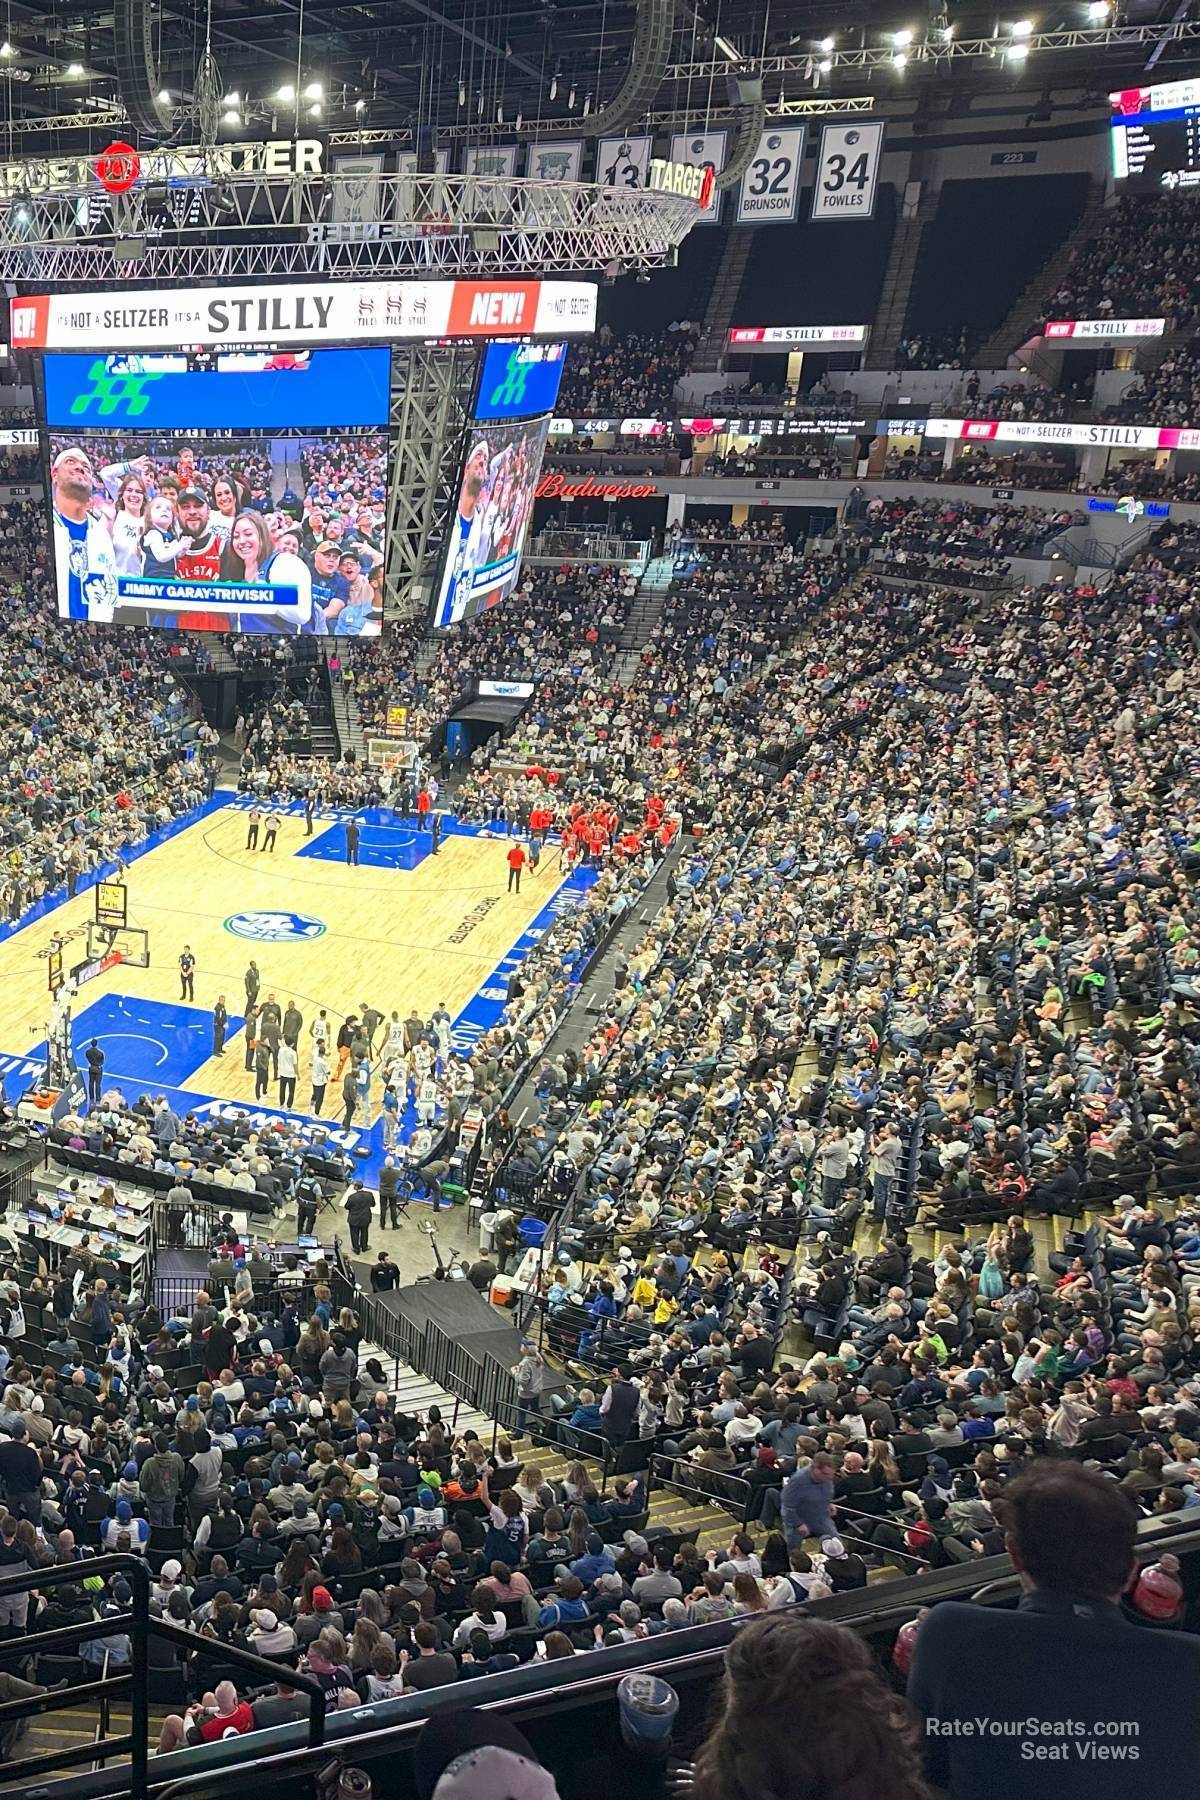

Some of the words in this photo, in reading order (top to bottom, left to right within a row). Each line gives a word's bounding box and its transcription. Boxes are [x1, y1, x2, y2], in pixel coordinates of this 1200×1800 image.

[1002, 153, 1024, 164] 223
[605, 164, 639, 189] 13
[650, 159, 706, 199] TARGET
[749, 157, 792, 195] 32
[823, 152, 869, 192] 34
[743, 198, 791, 211] BRUNSON
[823, 194, 863, 207] FOWLES
[71, 312, 91, 328] NOT
[103, 308, 169, 328] SELTZER
[174, 312, 192, 322] IT'S
[194, 312, 200, 321] A
[208, 296, 334, 333] STILLY
[469, 292, 526, 326] NEW!
[13, 307, 36, 338] EW!
[1093, 323, 1129, 334] STILLY
[785, 329, 824, 340] STILLY
[553, 423, 565, 432] 41
[584, 421, 609, 432] 4:49
[630, 423, 643, 432] 52
[1016, 425, 1030, 436] NOT
[1037, 425, 1073, 438] SELTZER
[1089, 428, 1143, 444] STILLY
[535, 474, 657, 498] Budweiser
[178, 565, 220, 582] LL-STAR
[123, 582, 163, 598] JIMMY
[166, 585, 274, 603] GARAY-TRIVISKI
[223, 802, 367, 824] MINNESOTA
[474, 896, 502, 917] TARGET
[447, 921, 478, 945] CENTER
[315, 1027, 324, 1036] 23
[392, 1030, 402, 1038] 27
[424, 1090, 433, 1099] 10
[508, 1531, 520, 1542] 5
